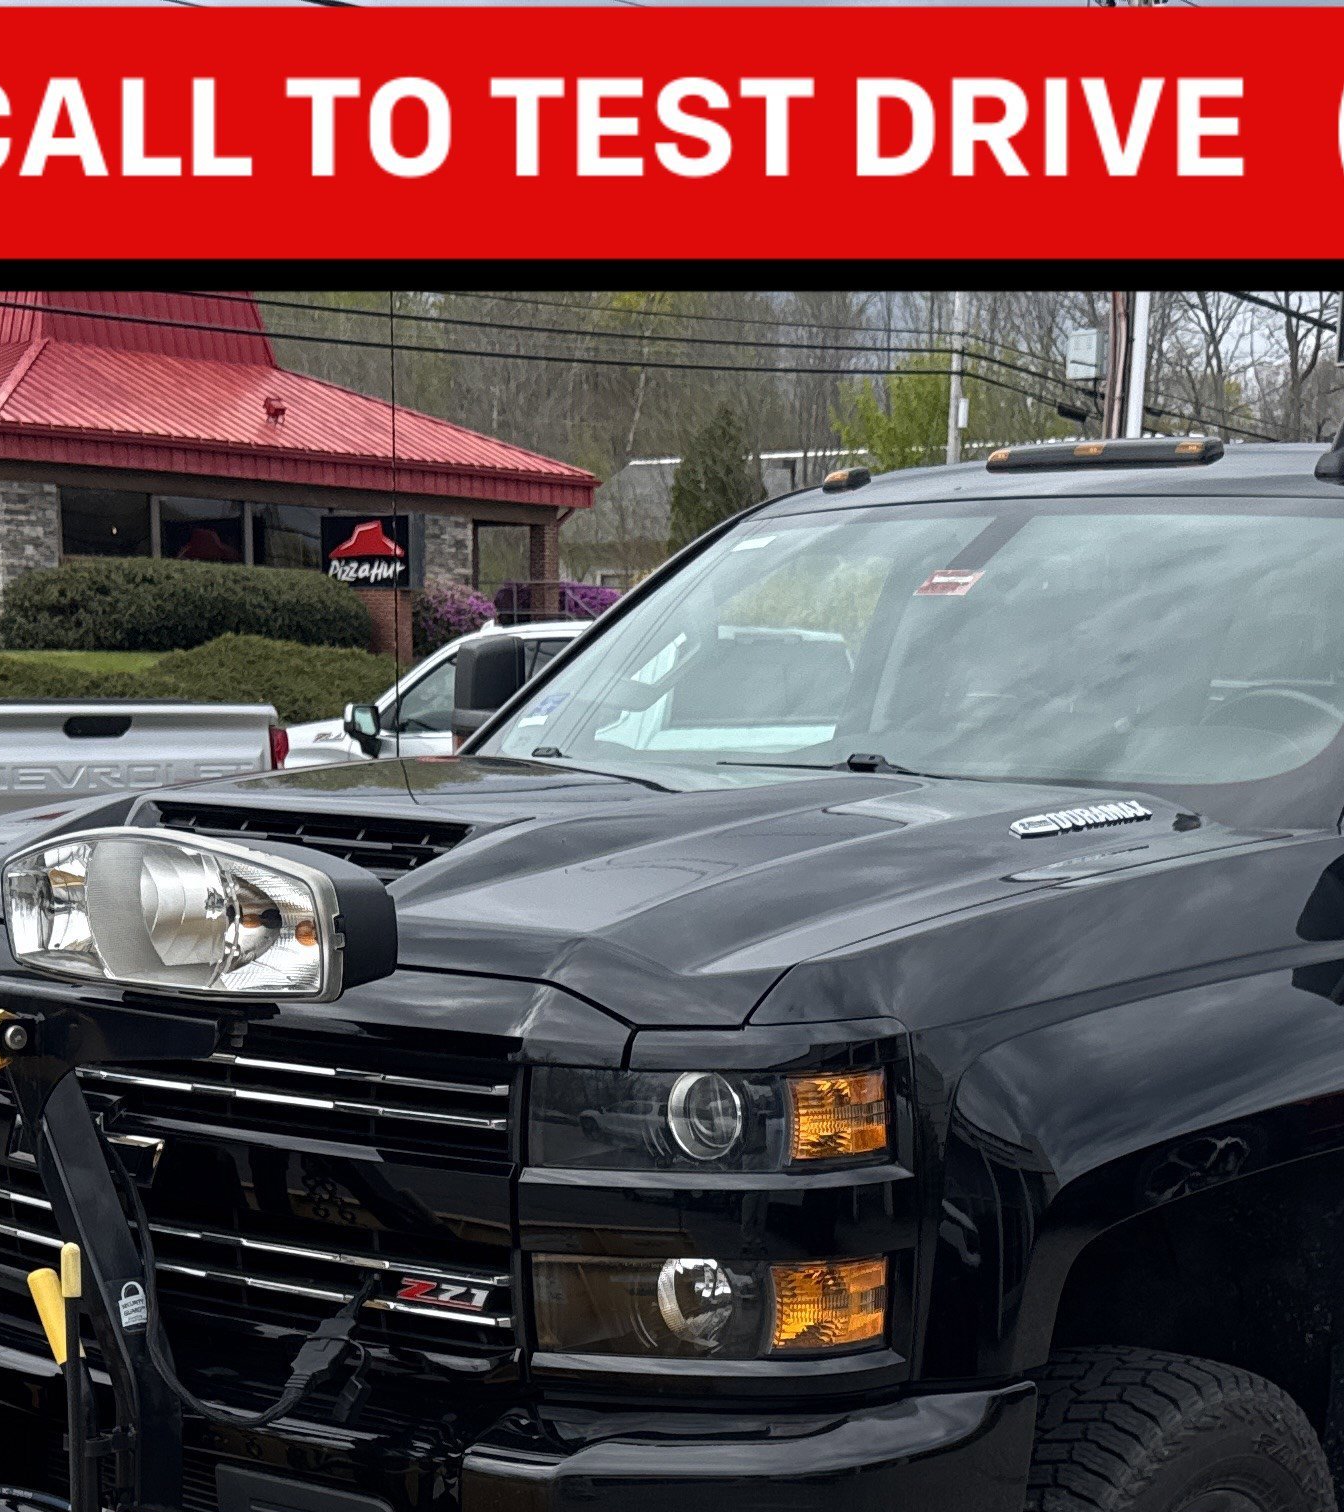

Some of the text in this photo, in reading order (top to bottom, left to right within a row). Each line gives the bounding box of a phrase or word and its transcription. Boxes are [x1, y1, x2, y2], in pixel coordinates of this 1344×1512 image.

[328, 559, 371, 582] Pizza
[1046, 800, 1153, 831] DURAMAX
[396, 1276, 490, 1312] Z71
